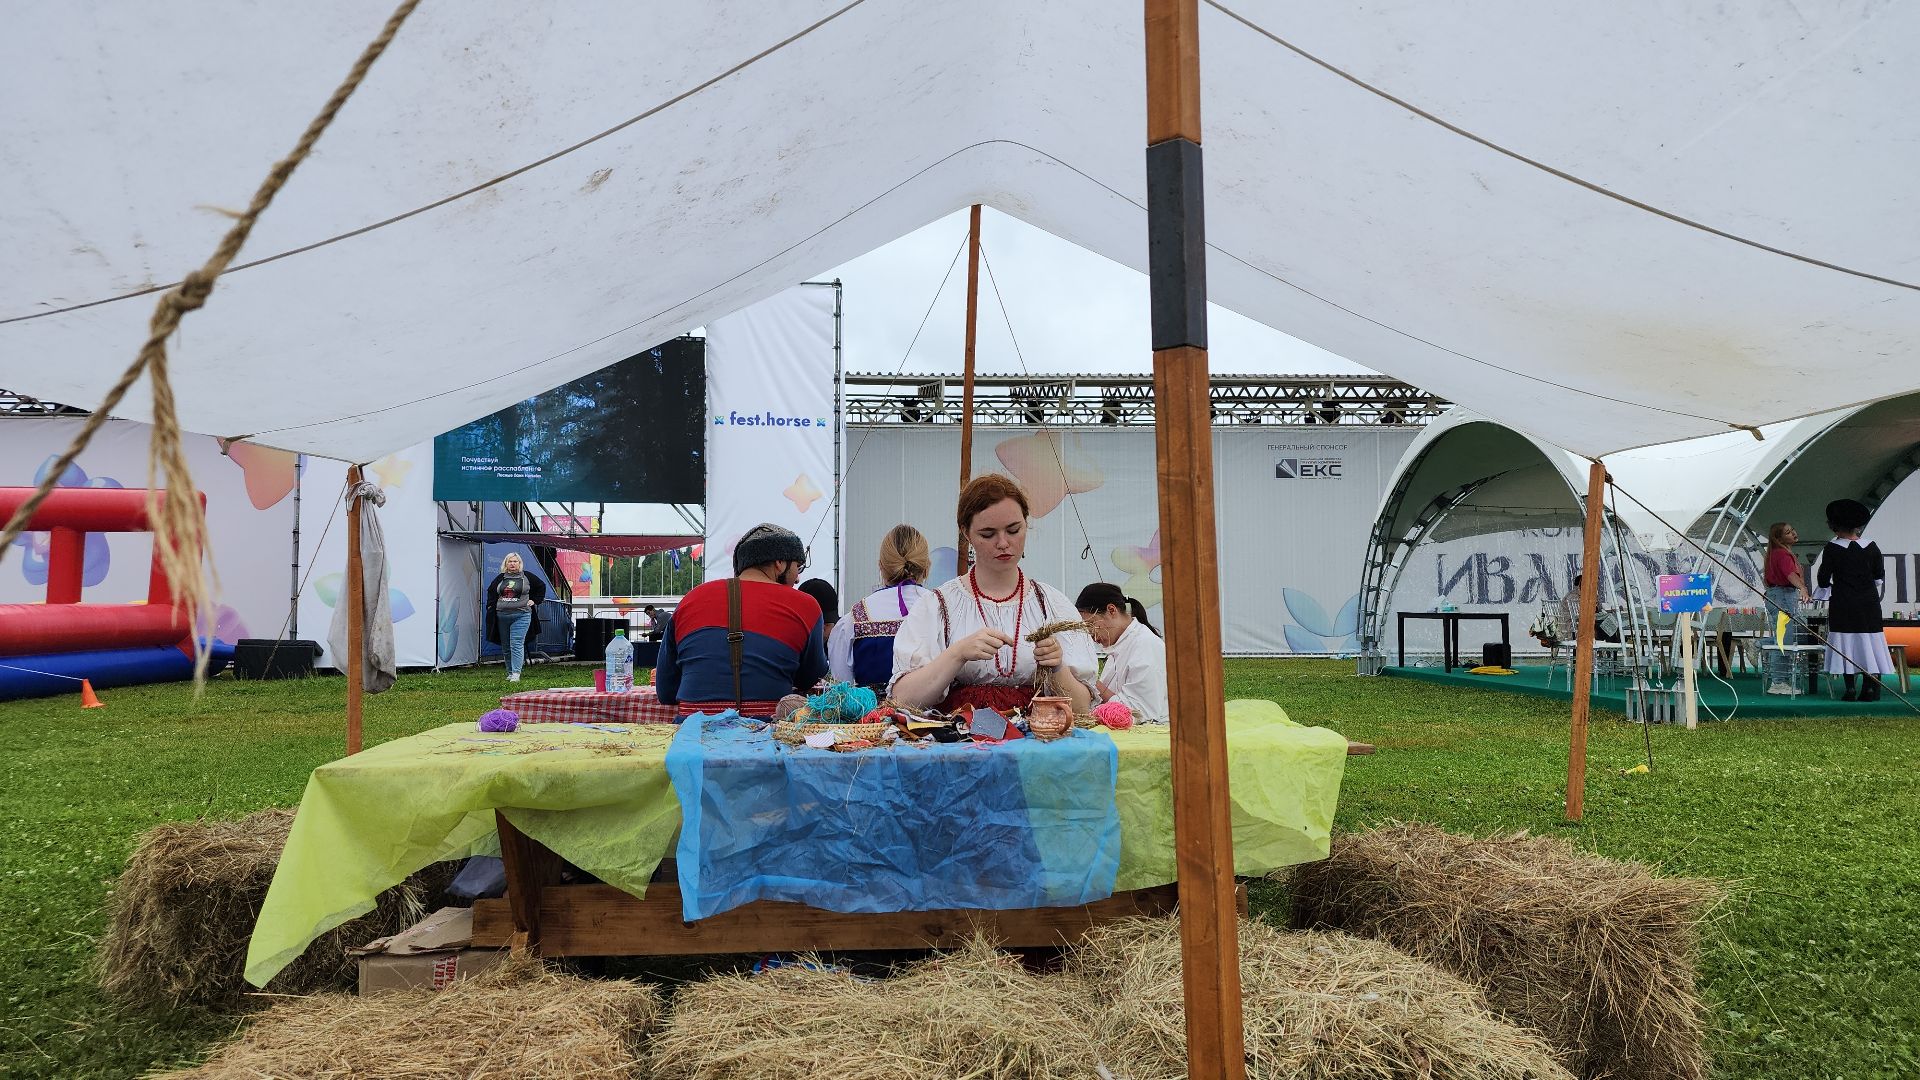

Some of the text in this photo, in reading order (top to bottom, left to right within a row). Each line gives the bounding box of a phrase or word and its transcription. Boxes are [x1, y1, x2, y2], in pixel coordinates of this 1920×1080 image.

[729, 411, 811, 427] fest.horse
[1267, 443, 1315, 451] ГЕНЕРАЛЬНЫЙ
[461, 456, 499, 464] Почувствуй
[1300, 464, 1342, 477] ЕКС
[1663, 588, 1709, 597] АКВАГРИМ
